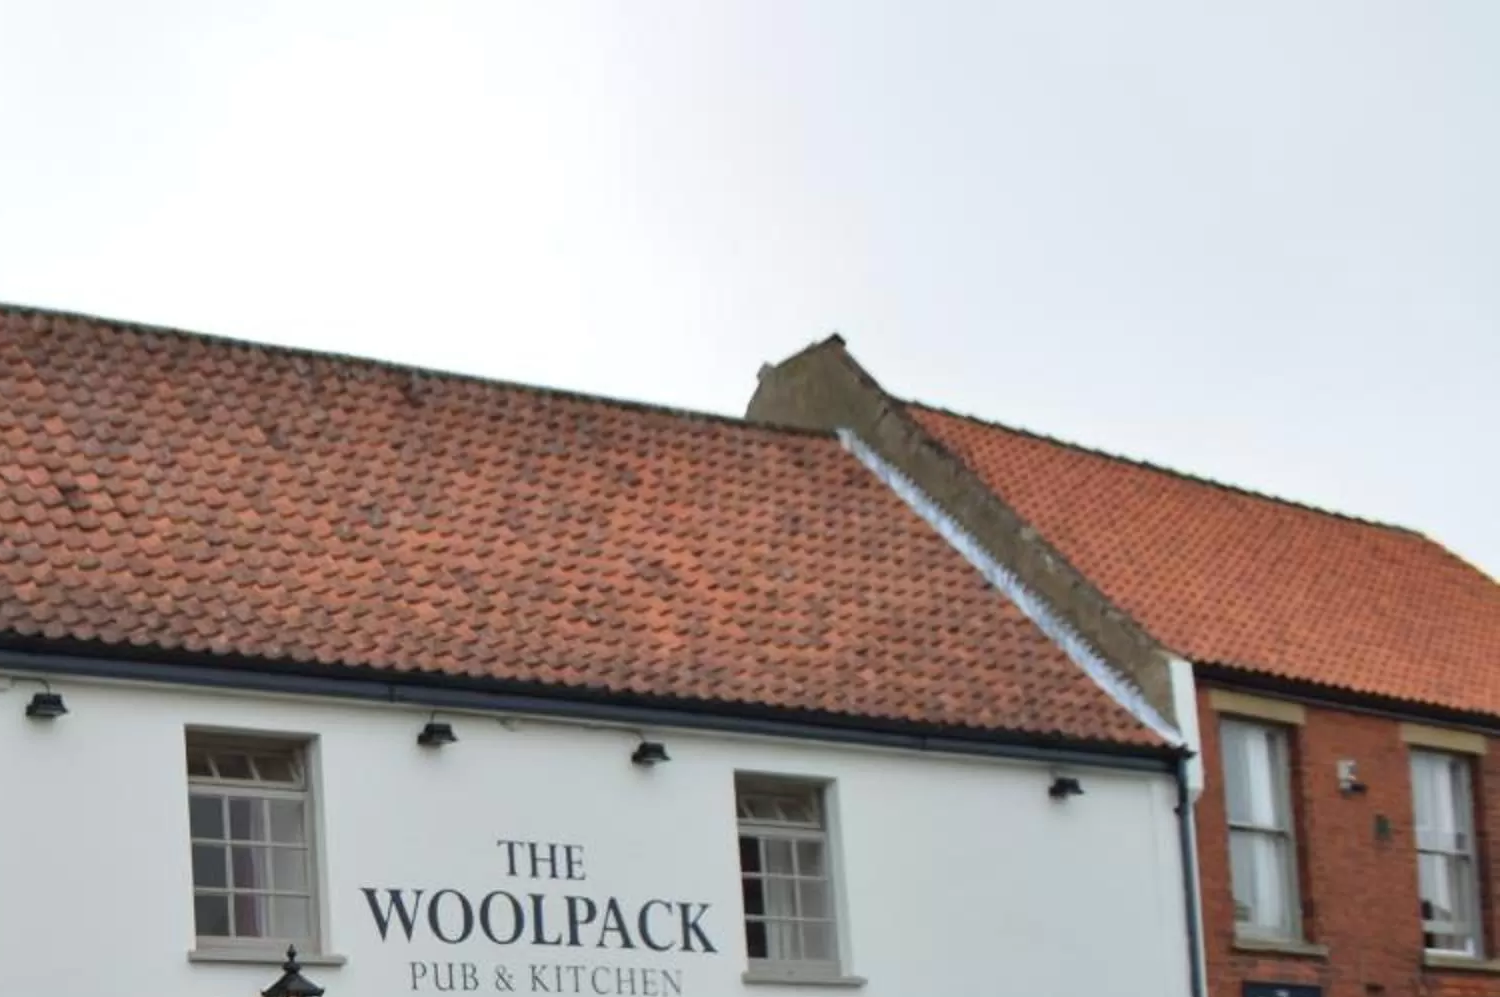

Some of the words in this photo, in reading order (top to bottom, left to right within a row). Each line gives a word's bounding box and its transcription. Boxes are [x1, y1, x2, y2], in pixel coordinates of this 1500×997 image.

[496, 839, 587, 882] THE
[359, 886, 719, 954] WOOLPACK
[409, 960, 480, 992] PUB
[494, 963, 516, 993] &
